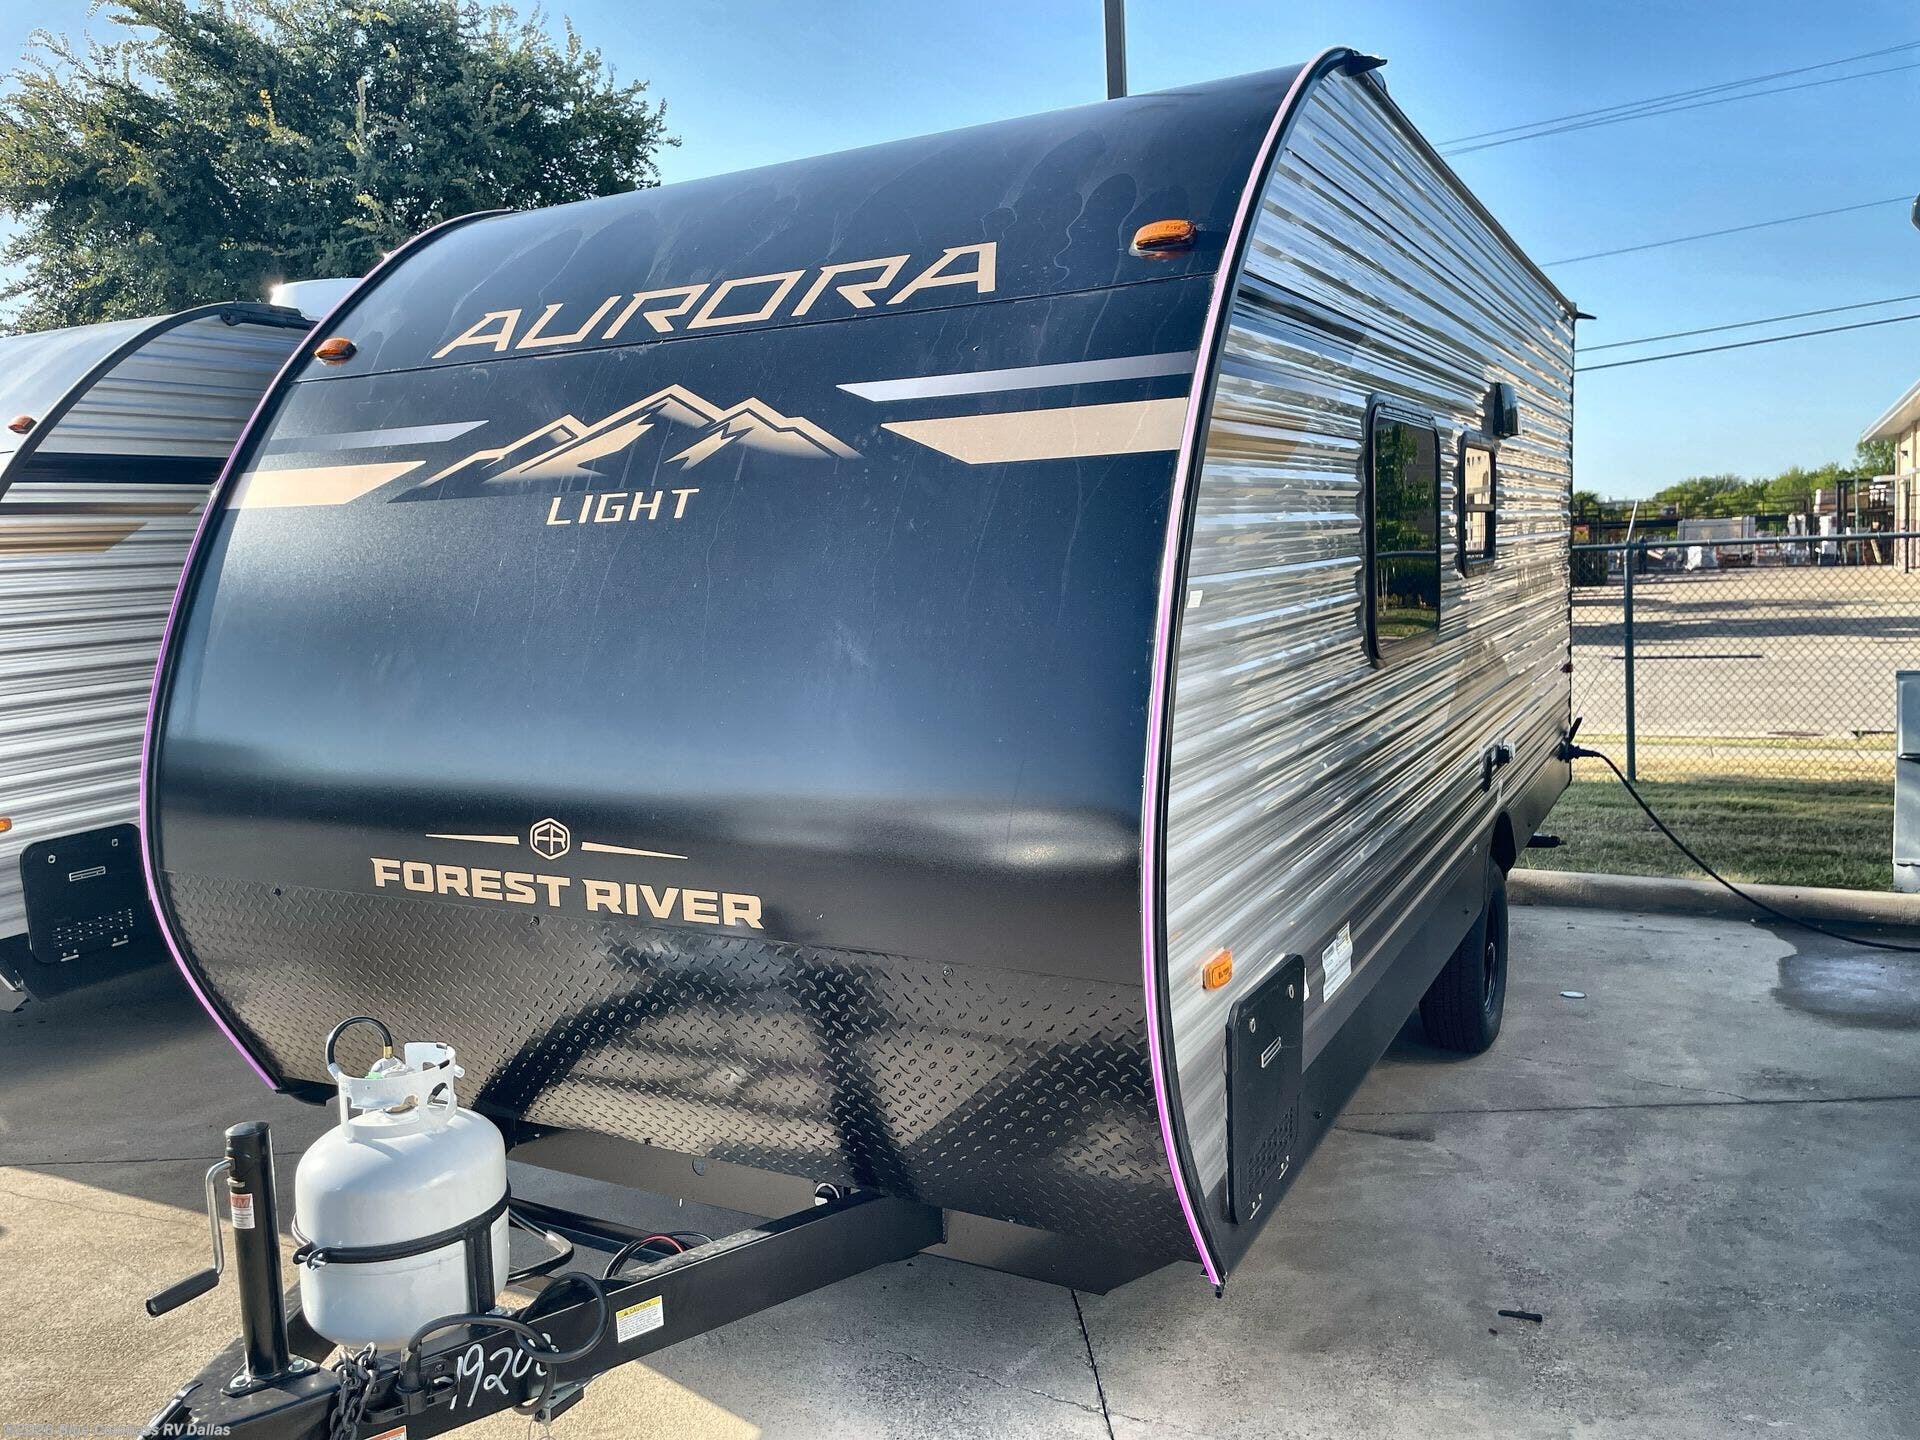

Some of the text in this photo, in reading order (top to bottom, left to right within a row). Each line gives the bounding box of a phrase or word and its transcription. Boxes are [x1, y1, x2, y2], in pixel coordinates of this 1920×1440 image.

[432, 241, 997, 360] AURORA
[546, 487, 700, 526] LIGHT
[370, 857, 765, 930] FOREST RIVER
